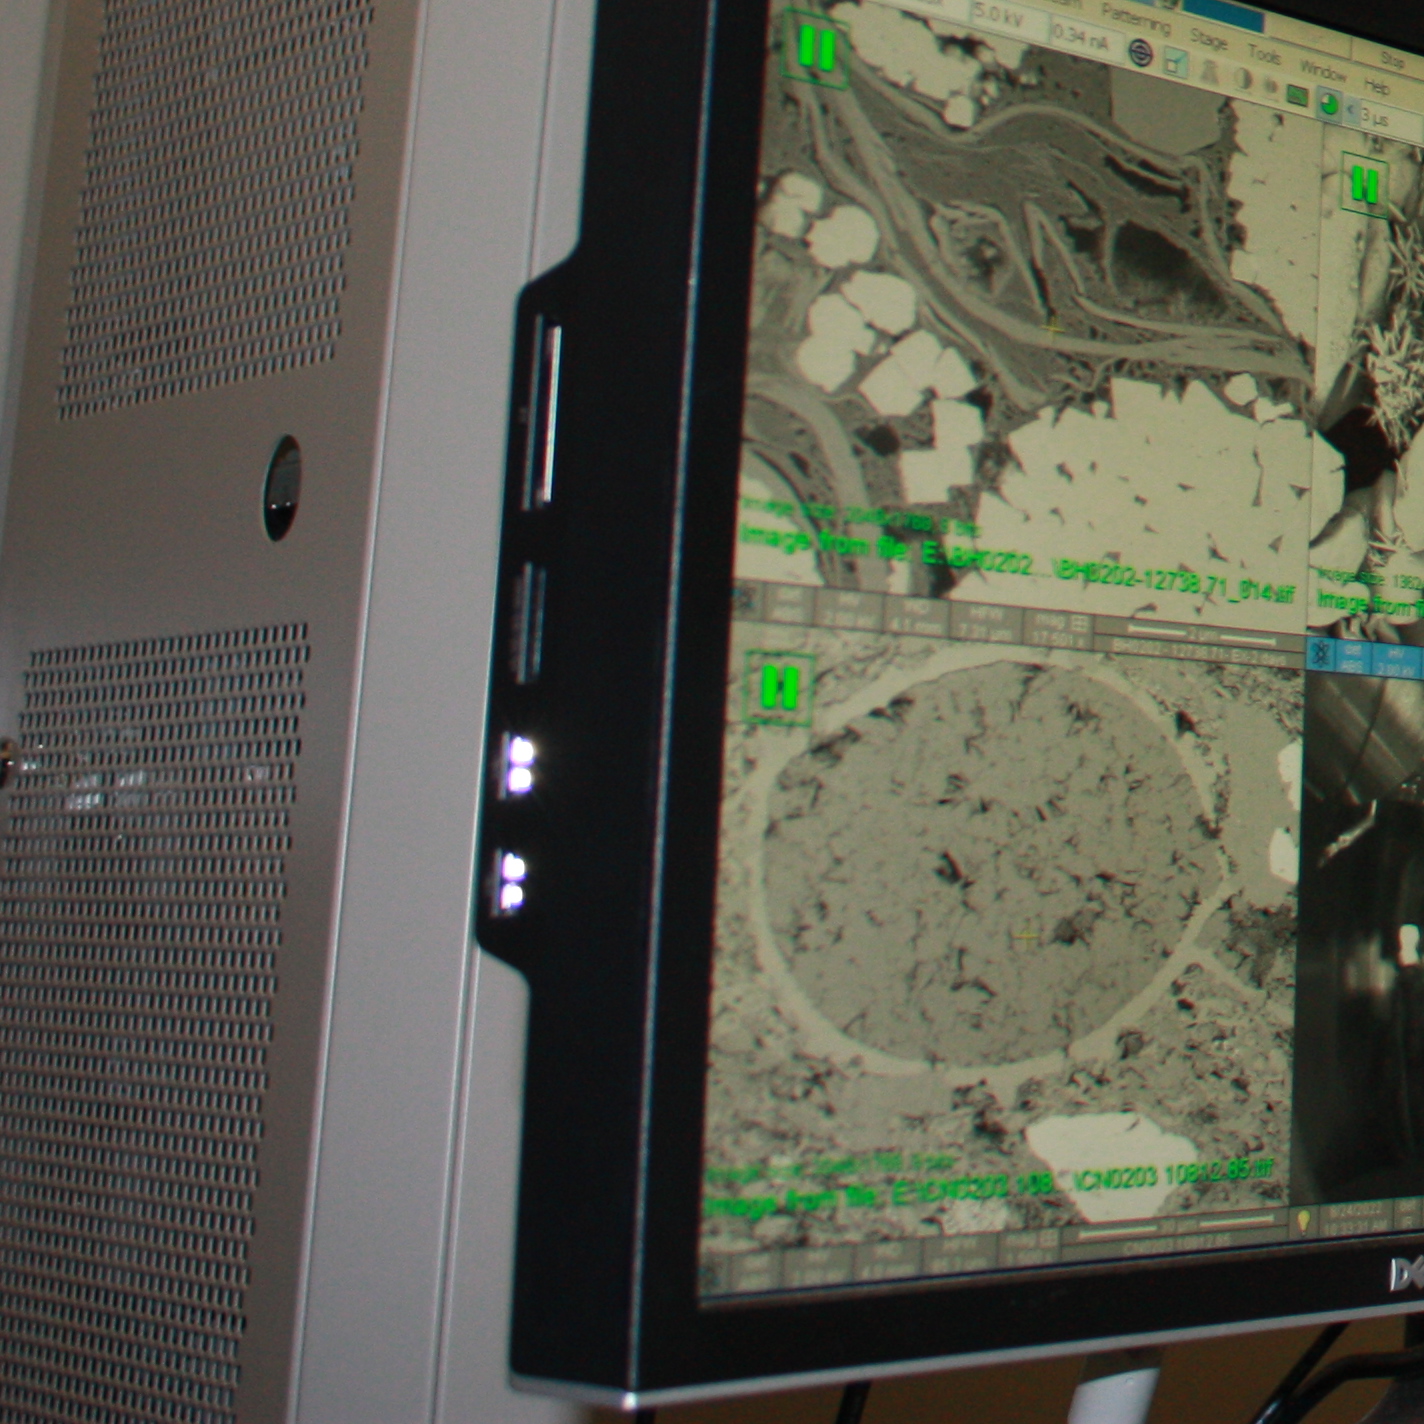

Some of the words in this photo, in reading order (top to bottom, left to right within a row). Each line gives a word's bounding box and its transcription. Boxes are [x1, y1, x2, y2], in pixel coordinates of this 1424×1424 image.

[973, 0, 1000, 21] 5.0
[1004, 9, 1025, 28] kV
[1052, 23, 1085, 44] 0.34
[1089, 34, 1110, 51] nA
[1361, 108, 1370, 121] 3
[1102, 2, 1172, 38] Patterning
[1191, 27, 1228, 52] Stage
[1248, 43, 1282, 66] Tools
[1301, 59, 1348, 83] Window
[1364, 77, 1391, 96] Help
[1381, 51, 1405, 70] Stop
[740, 522, 812, 555] Image
[818, 528, 869, 554] from
[1317, 588, 1368, 615] Image
[1372, 594, 1412, 618] from
